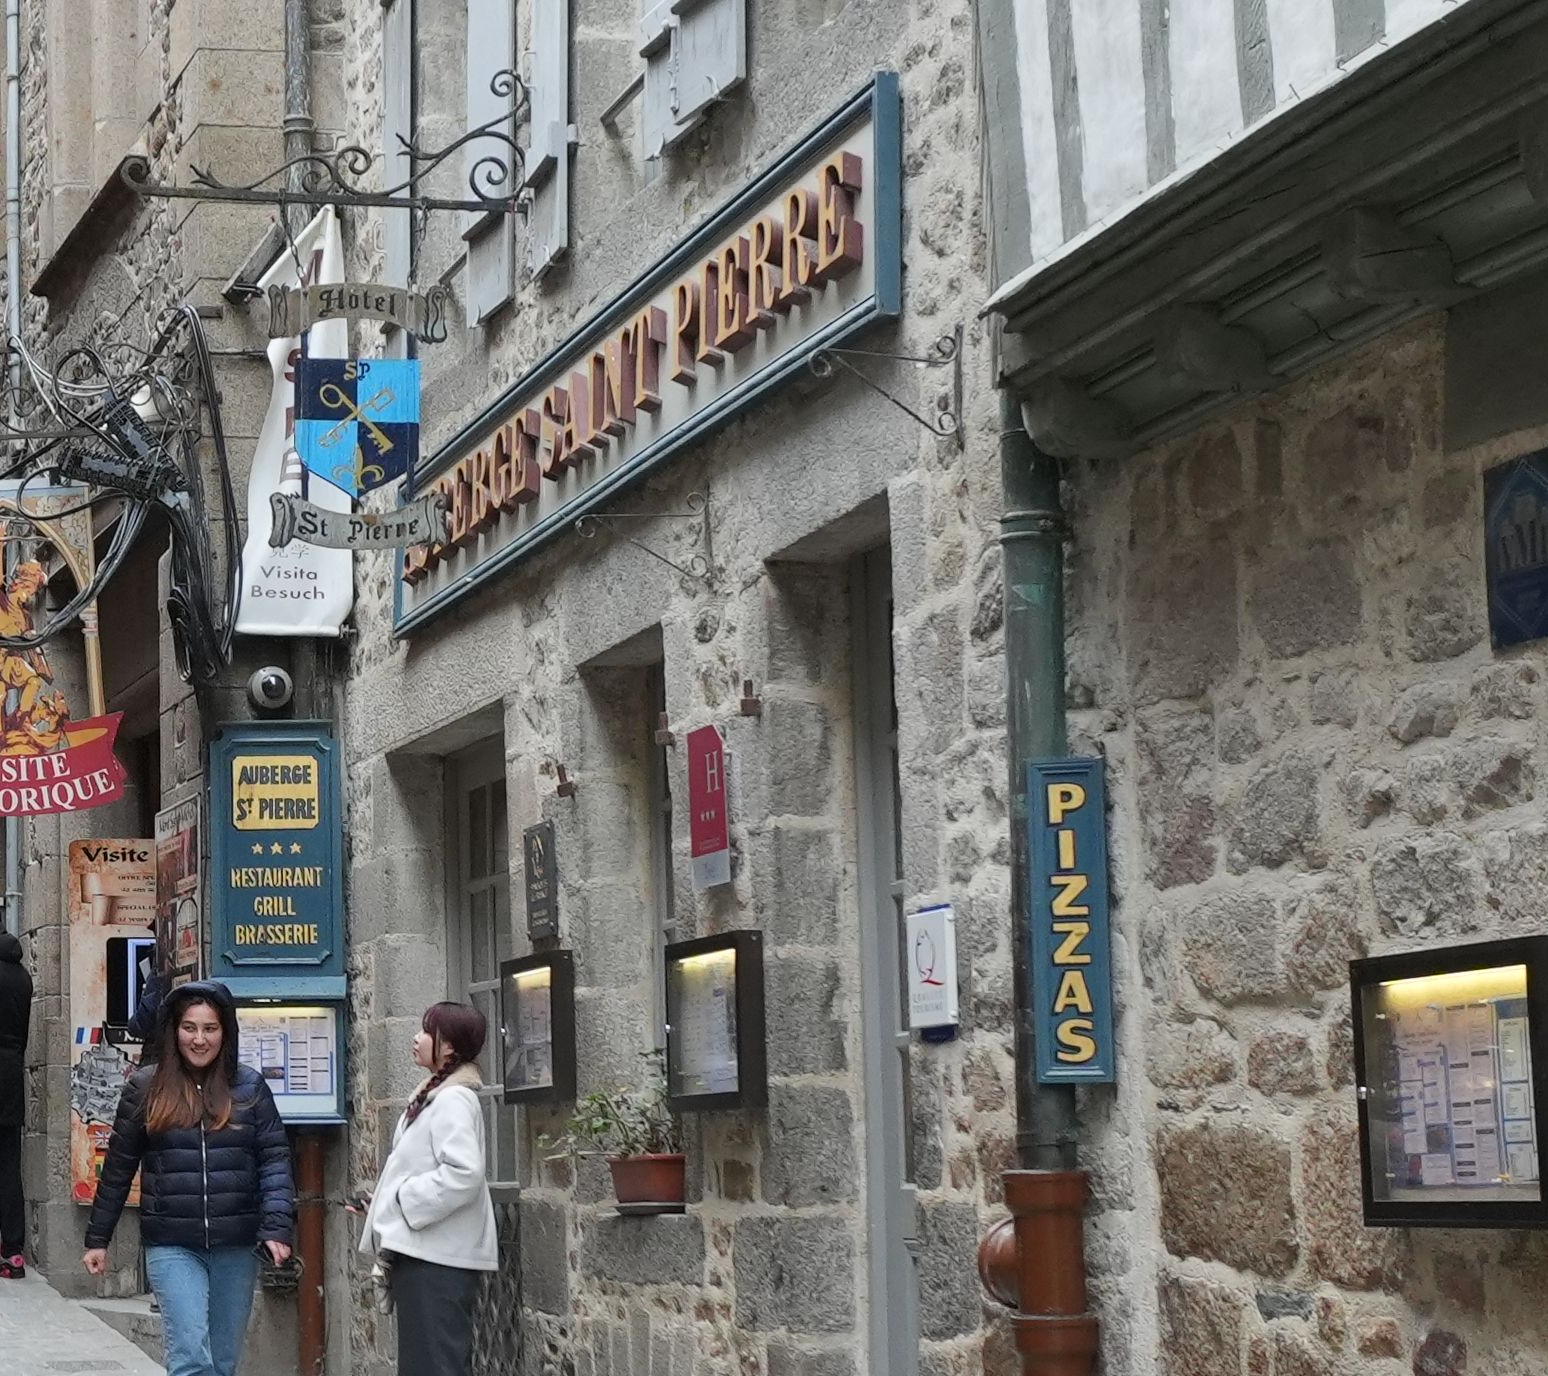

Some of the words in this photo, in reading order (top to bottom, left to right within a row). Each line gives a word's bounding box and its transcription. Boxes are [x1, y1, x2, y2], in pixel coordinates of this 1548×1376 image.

[402, 409, 541, 584] BERGE
[542, 306, 667, 481] SAINT
[671, 150, 862, 386] PIERRE
[298, 511, 328, 535] St
[347, 518, 419, 543] Pierre
[260, 565, 318, 580] Visita
[251, 585, 325, 600] Besuch
[239, 765, 312, 786] AUBERGE
[704, 751, 721, 794] H
[259, 798, 316, 820] PIERRE
[81, 846, 150, 863] Visite
[231, 867, 324, 889] RESTAURANT
[254, 896, 297, 917] GRILL
[1047, 783, 1097, 1064] PIZZAS
[235, 924, 319, 946] BRASSERIE
